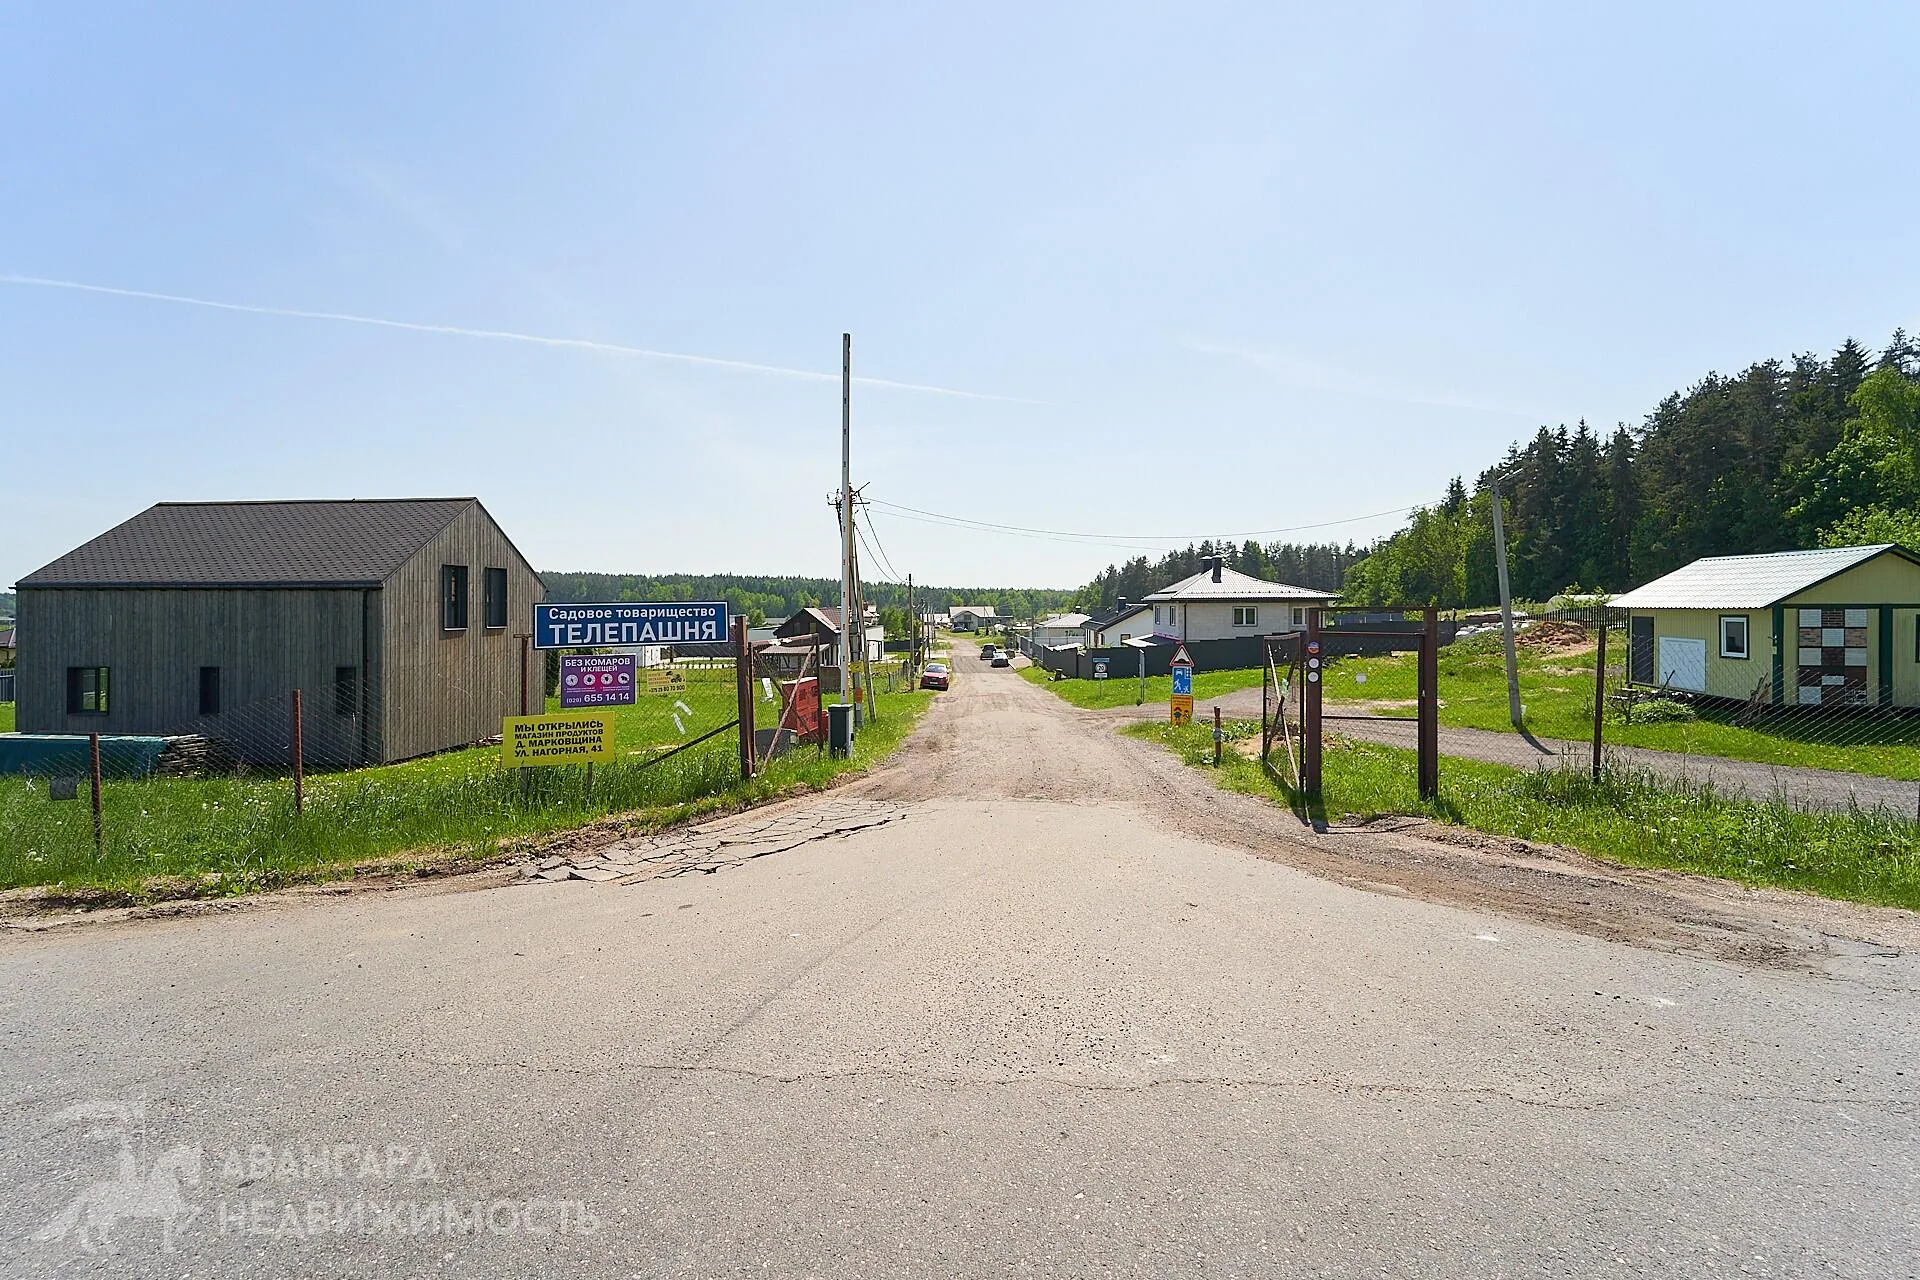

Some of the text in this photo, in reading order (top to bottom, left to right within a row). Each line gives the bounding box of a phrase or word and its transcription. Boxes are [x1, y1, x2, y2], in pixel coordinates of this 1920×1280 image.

[549, 607, 716, 620] Садовое товарищество
[549, 621, 717, 644] ТЕЛЕПАШНЯ
[565, 658, 631, 667] БЕЗ КОМАРОВ
[588, 665, 618, 673] КЛЕЩЕЙ
[584, 693, 603, 703] 655
[605, 693, 617, 701] 14
[619, 692, 630, 701] 14
[515, 720, 604, 733] МЫ ОТКРЫЛИСЬ
[515, 728, 604, 740] МАГАЗИН ПРОДУКТОВ
[516, 736, 602, 749] Д. МАРКОВЩИНА
[515, 749, 529, 758] УЛ.
[532, 746, 589, 757] НАГОРНАЯ,
